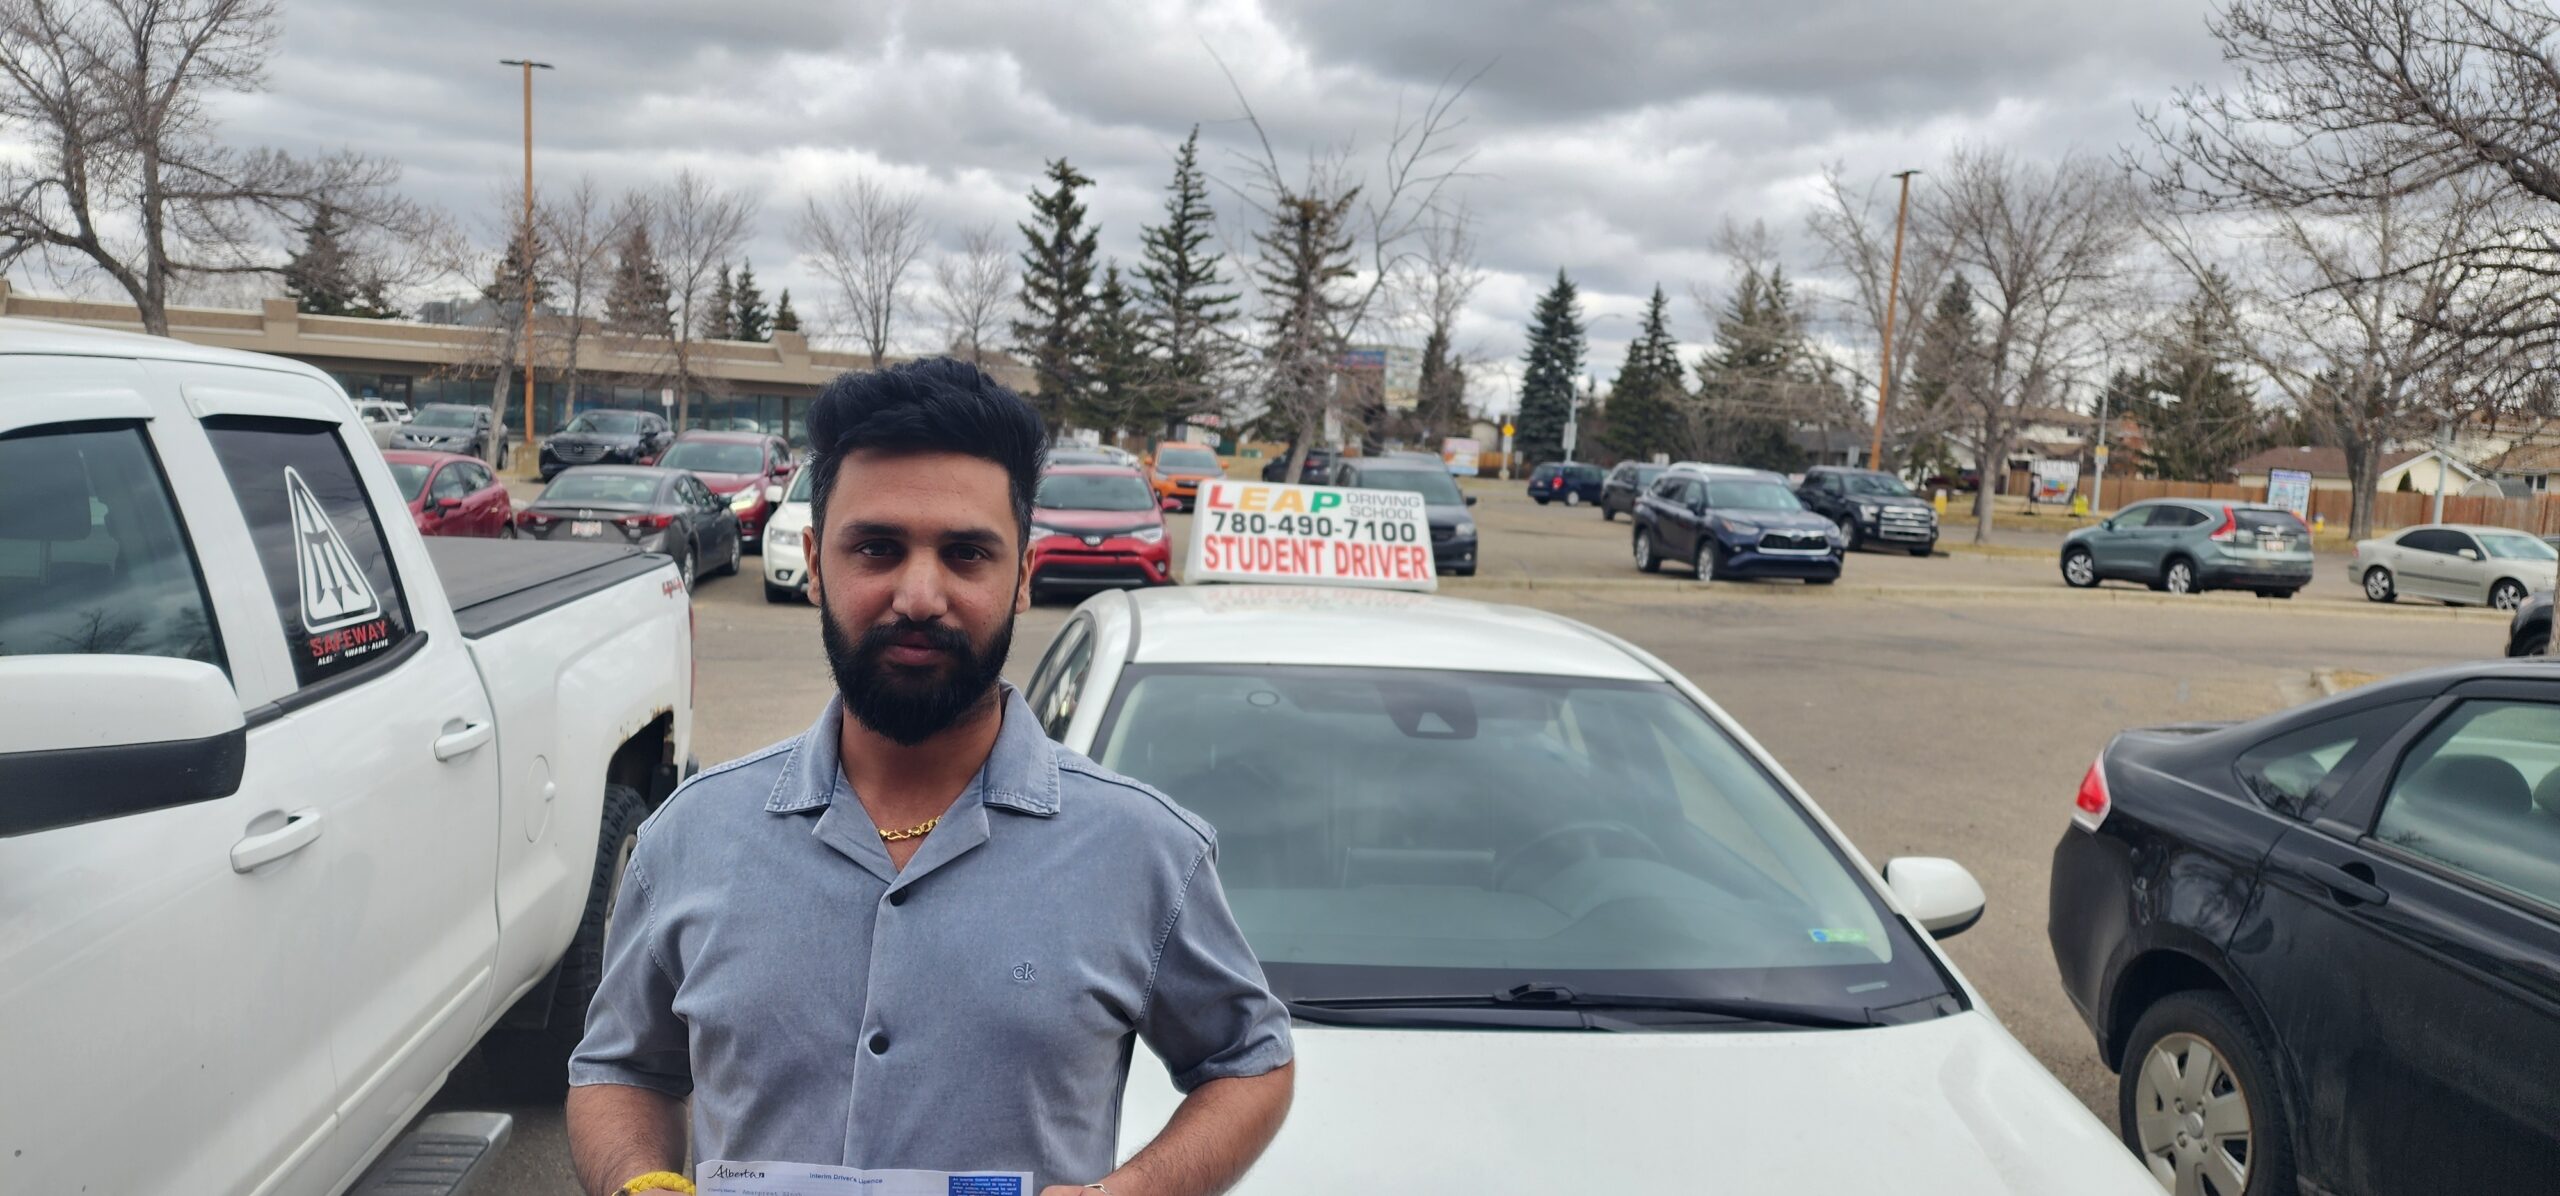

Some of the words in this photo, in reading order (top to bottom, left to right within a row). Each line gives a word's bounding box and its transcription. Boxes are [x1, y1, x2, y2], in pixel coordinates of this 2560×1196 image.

[1207, 484, 1342, 513] LEAP
[1346, 493, 1421, 508] DRIVING
[1350, 505, 1418, 520] SCHOOL
[1211, 511, 1416, 542] 780-490-7100
[1204, 534, 1325, 575] STUDENT
[1334, 540, 1430, 580] DRIVER
[310, 620, 386, 657] SAFEWAY
[371, 638, 389, 651] ALIVE
[708, 1164, 759, 1179] Alberta
[833, 1174, 857, 1183] Driver's
